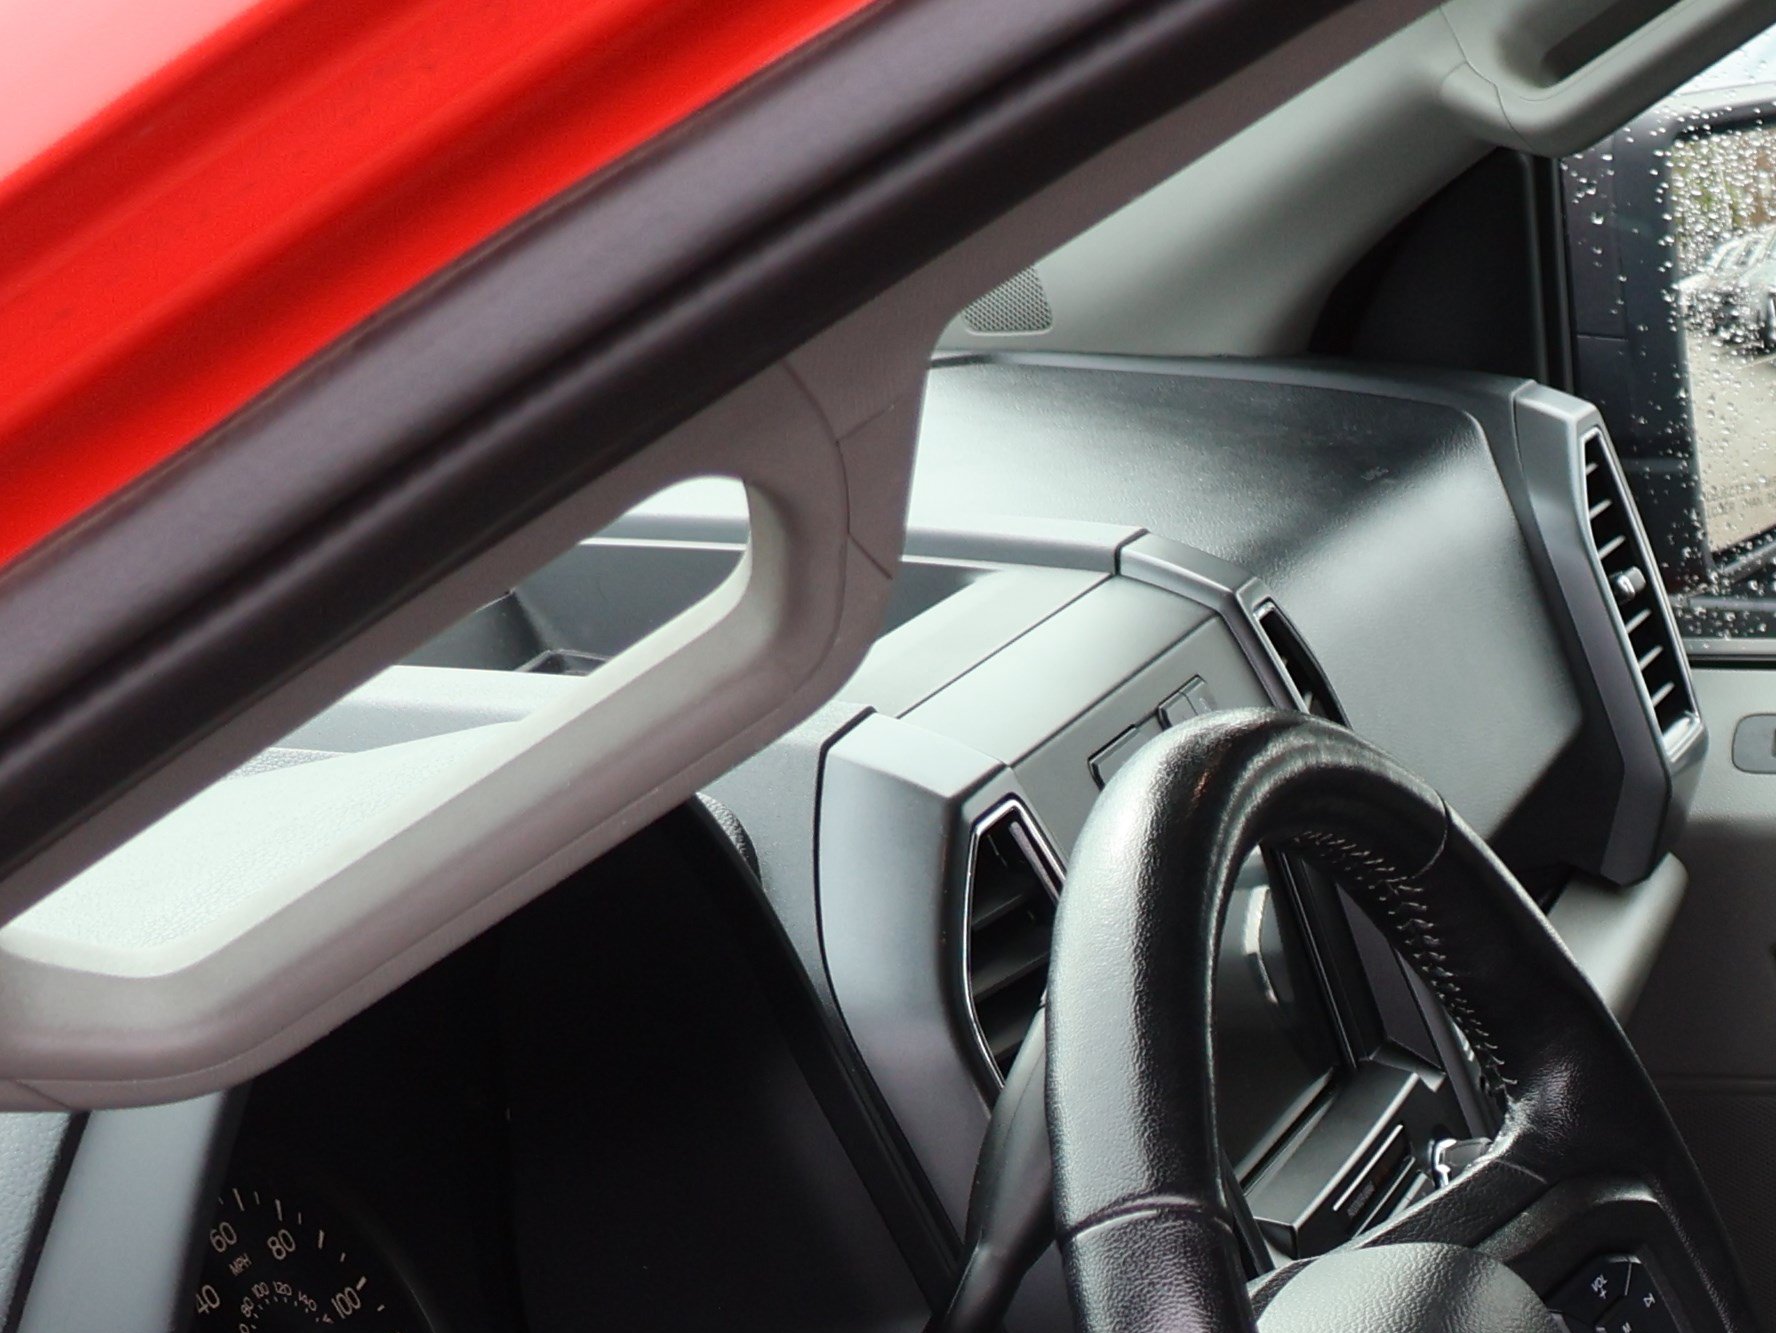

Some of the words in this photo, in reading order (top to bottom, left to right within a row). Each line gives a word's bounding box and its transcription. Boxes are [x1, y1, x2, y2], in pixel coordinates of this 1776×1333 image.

[209, 1221, 237, 1253] 60
[267, 1229, 296, 1260] 80
[228, 1253, 252, 1276] MPH
[196, 1284, 221, 1314] 40
[331, 1287, 361, 1319] 100
